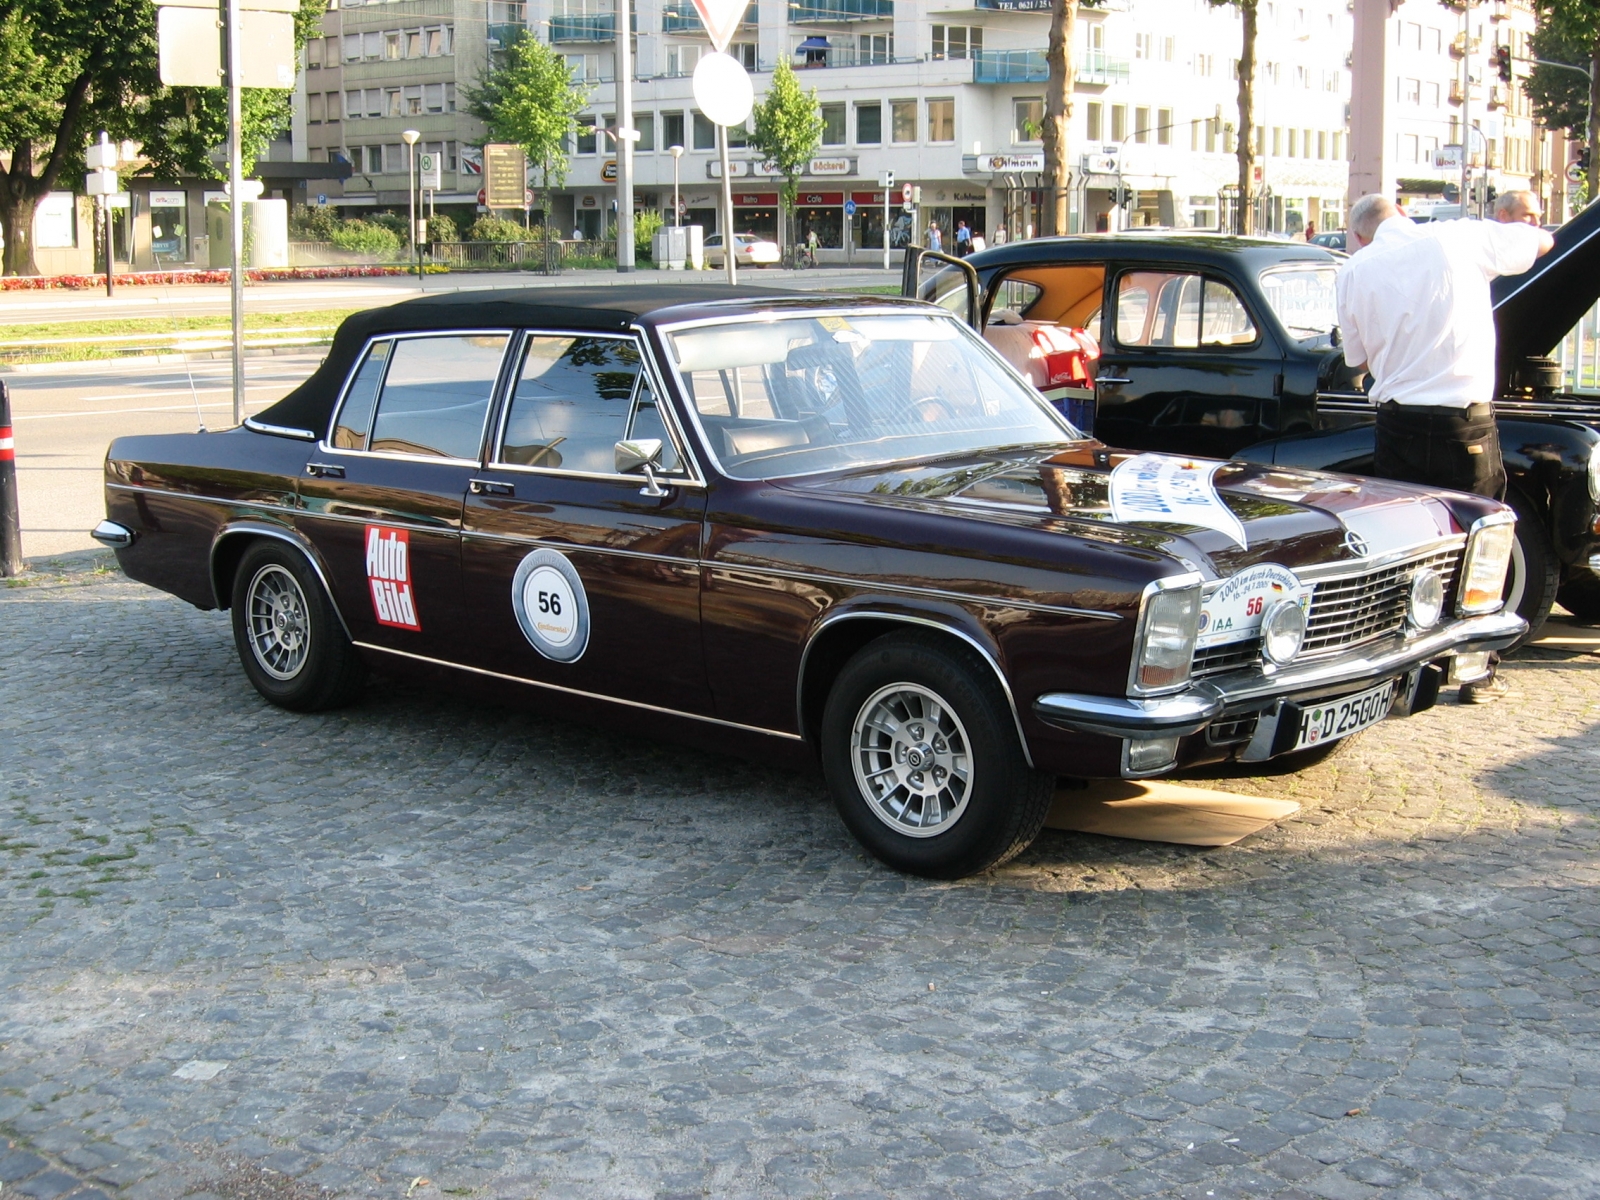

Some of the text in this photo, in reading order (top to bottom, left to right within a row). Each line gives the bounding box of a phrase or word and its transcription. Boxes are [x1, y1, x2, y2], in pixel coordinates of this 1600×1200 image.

[998, 2, 1017, 10] TEL.
[1018, 1, 1034, 9] 0621
[366, 527, 407, 582] Auto
[1219, 568, 1296, 602] 2000 km durch Deutschland
[371, 578, 417, 626] Bild
[538, 590, 562, 616] 56
[1246, 596, 1263, 616] 56
[1212, 617, 1233, 632] IAA
[1320, 708, 1336, 739] D
